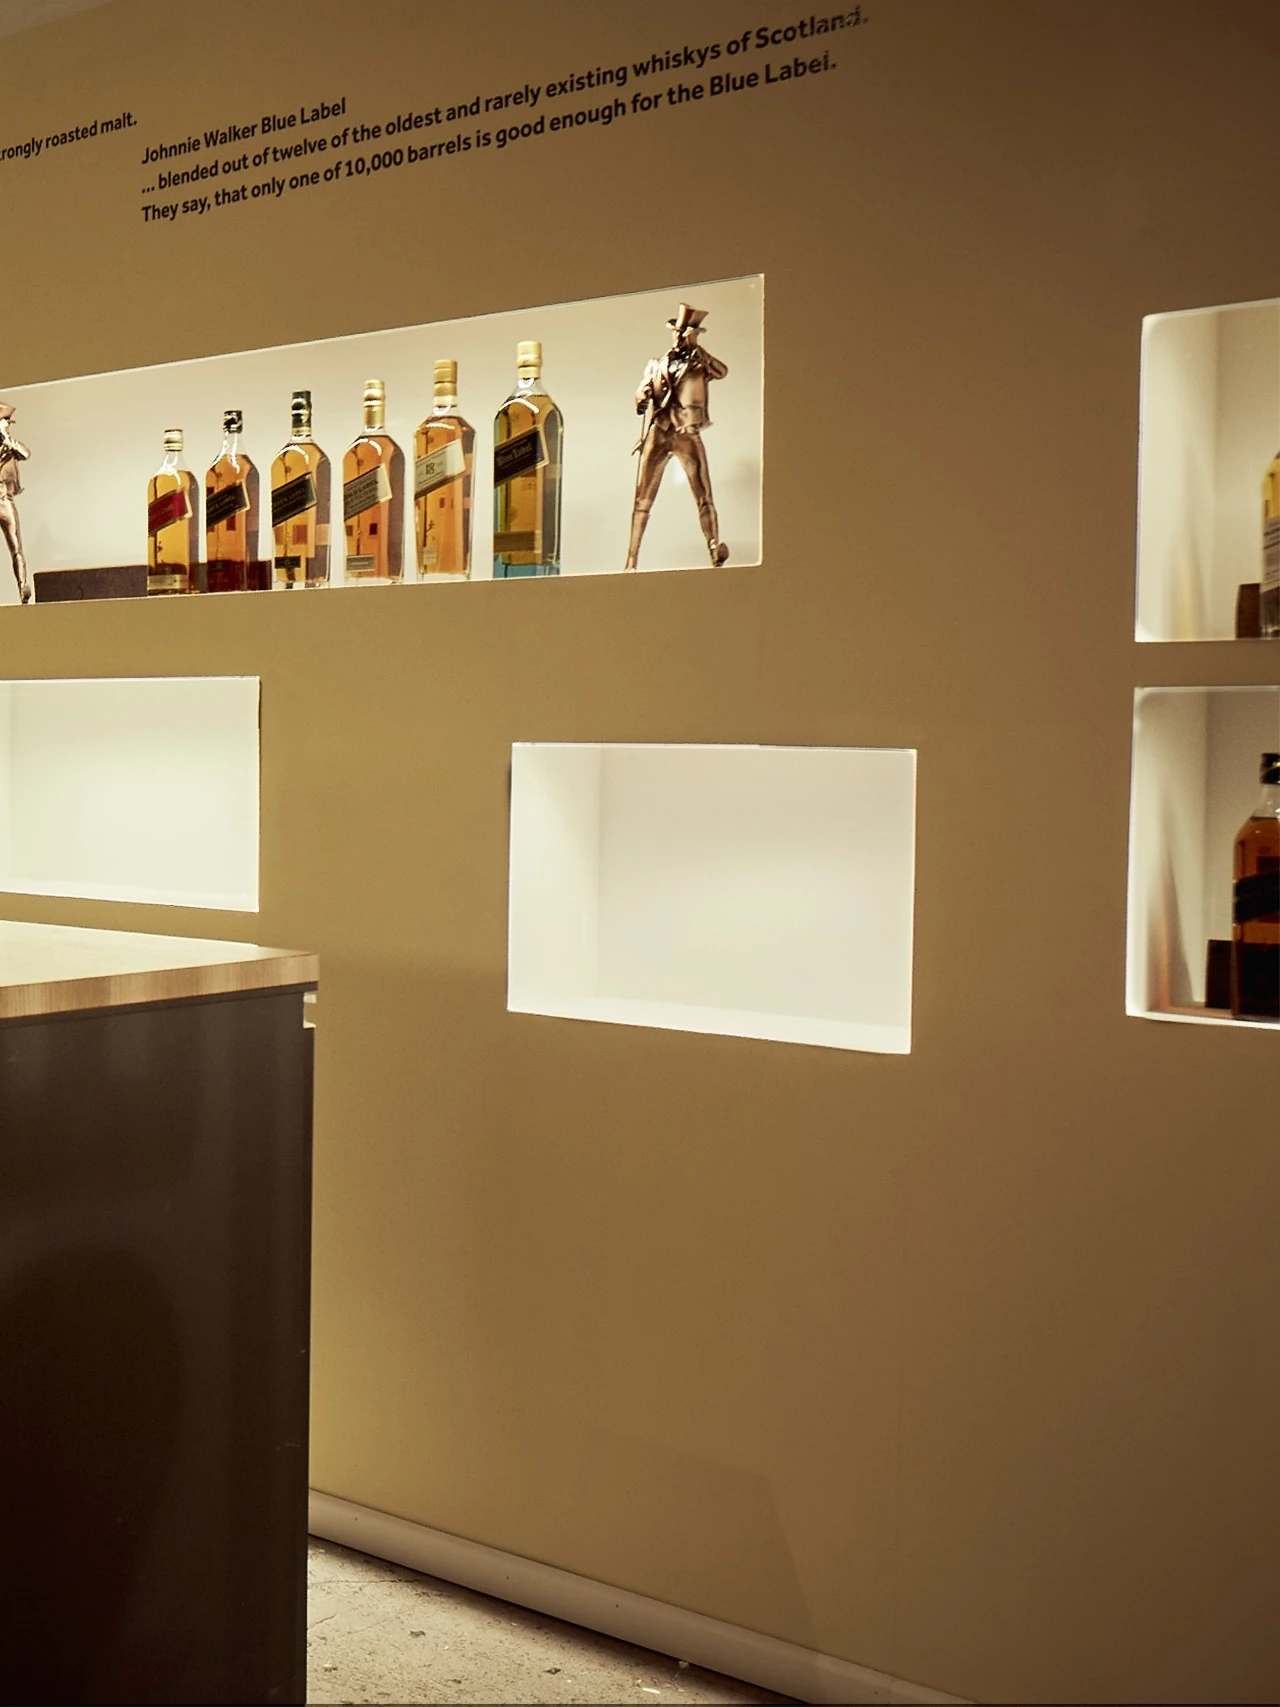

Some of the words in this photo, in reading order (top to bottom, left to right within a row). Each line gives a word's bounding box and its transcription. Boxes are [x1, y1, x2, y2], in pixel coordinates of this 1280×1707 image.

[46, 120, 97, 149] roasted
[101, 112, 137, 134] malt.
[141, 136, 201, 164] Johnnie
[204, 124, 258, 148] Walker
[261, 115, 296, 134] Blue
[301, 97, 345, 124] Label
[141, 203, 179, 222] They
[182, 197, 211, 214] say,
[214, 185, 248, 206] that
[251, 176, 286, 198] only
[289, 171, 320, 189] one
[323, 161, 342, 182] of
[345, 149, 404, 177] 10,000
[408, 134, 472, 163] barrels
[476, 130, 491, 148] is
[496, 115, 544, 148] good
[549, 98, 626, 131] enough
[631, 92, 663, 113] for
[667, 84, 704, 105] the
[710, 72, 759, 96] Blue
[159, 160, 218, 189] blended
[222, 154, 249, 174] out
[252, 147, 270, 167] of
[272, 138, 327, 162] twelve
[331, 127, 350, 148] of
[352, 124, 382, 143] the
[385, 107, 442, 135] oldest
[446, 96, 480, 121] and
[485, 84, 542, 112] rarely
[546, 66, 627, 97] existing
[632, 44, 721, 77] whiskys
[726, 31, 752, 55] of
